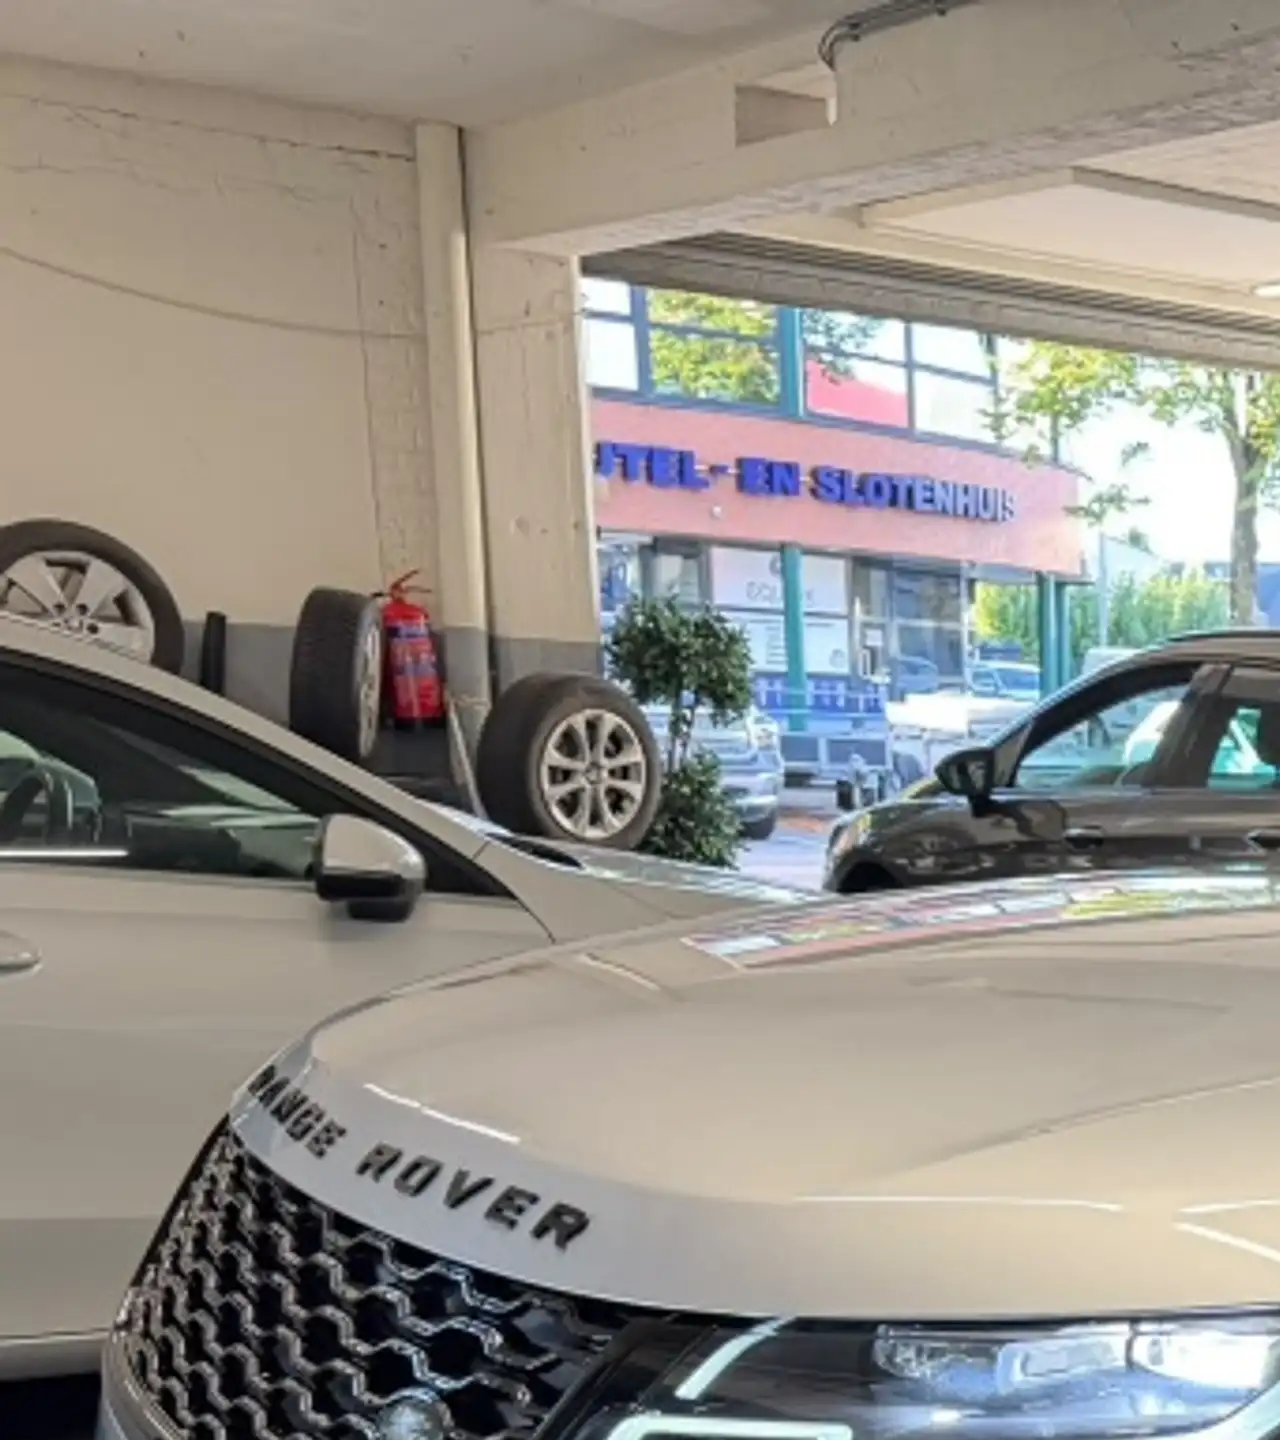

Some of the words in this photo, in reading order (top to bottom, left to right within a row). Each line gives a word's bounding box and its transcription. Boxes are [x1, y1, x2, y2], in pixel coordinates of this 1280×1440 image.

[736, 456, 800, 496] EN
[809, 464, 1017, 523] SLOTENHUIS
[248, 1064, 347, 1159] RANGE
[355, 1141, 591, 1252] ROVER
